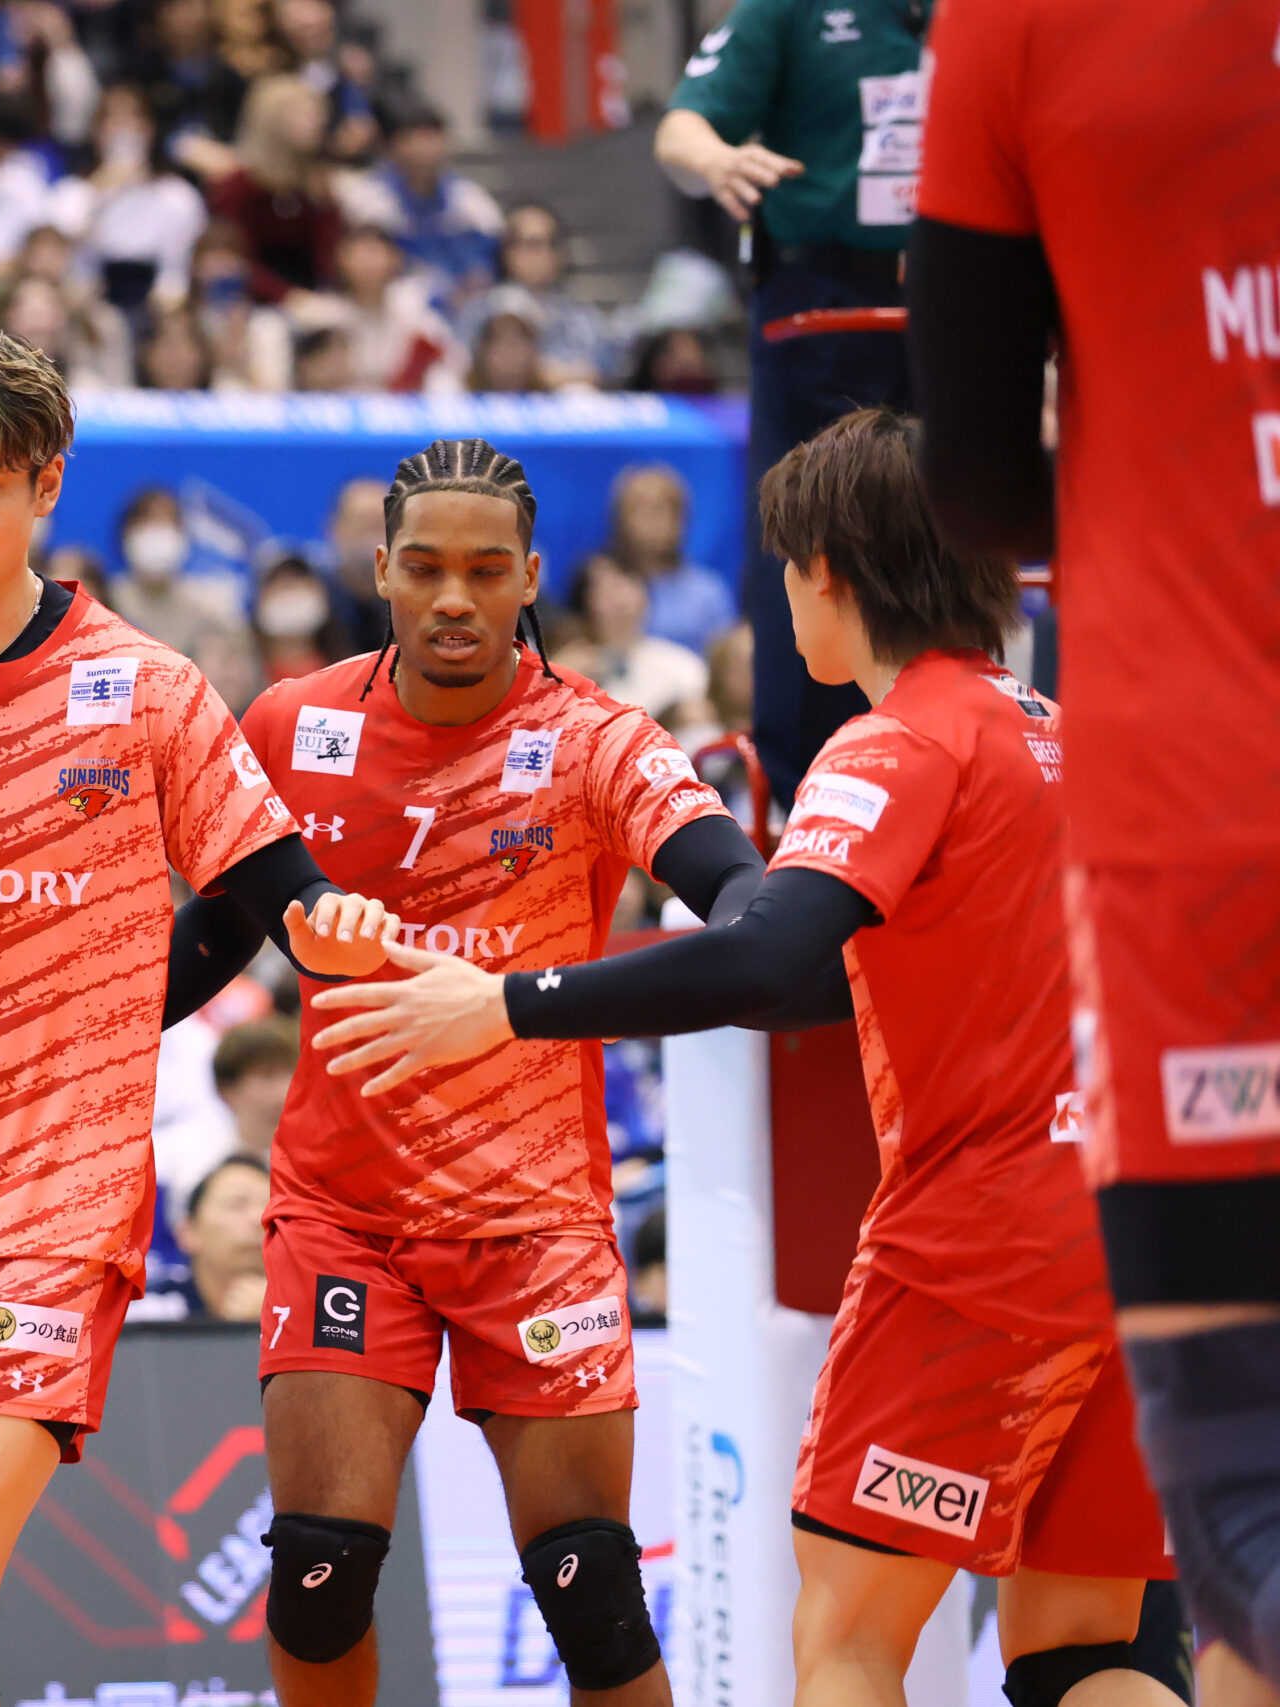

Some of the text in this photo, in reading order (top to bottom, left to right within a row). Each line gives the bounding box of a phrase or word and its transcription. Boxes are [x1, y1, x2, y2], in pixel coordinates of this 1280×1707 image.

[86, 668, 122, 677] SUNTORY
[93, 678, 111, 700] 生
[295, 735, 323, 749] SUI
[297, 726, 346, 738] SUNTORY GIN
[525, 749, 543, 771] 生
[57, 768, 130, 797] SUNBIRDS
[400, 805, 436, 869] 7
[399, 922, 526, 958] TORY
[19, 1321, 78, 1344] つの食品
[269, 1305, 291, 1350] 7
[561, 1310, 620, 1335] つの食品
